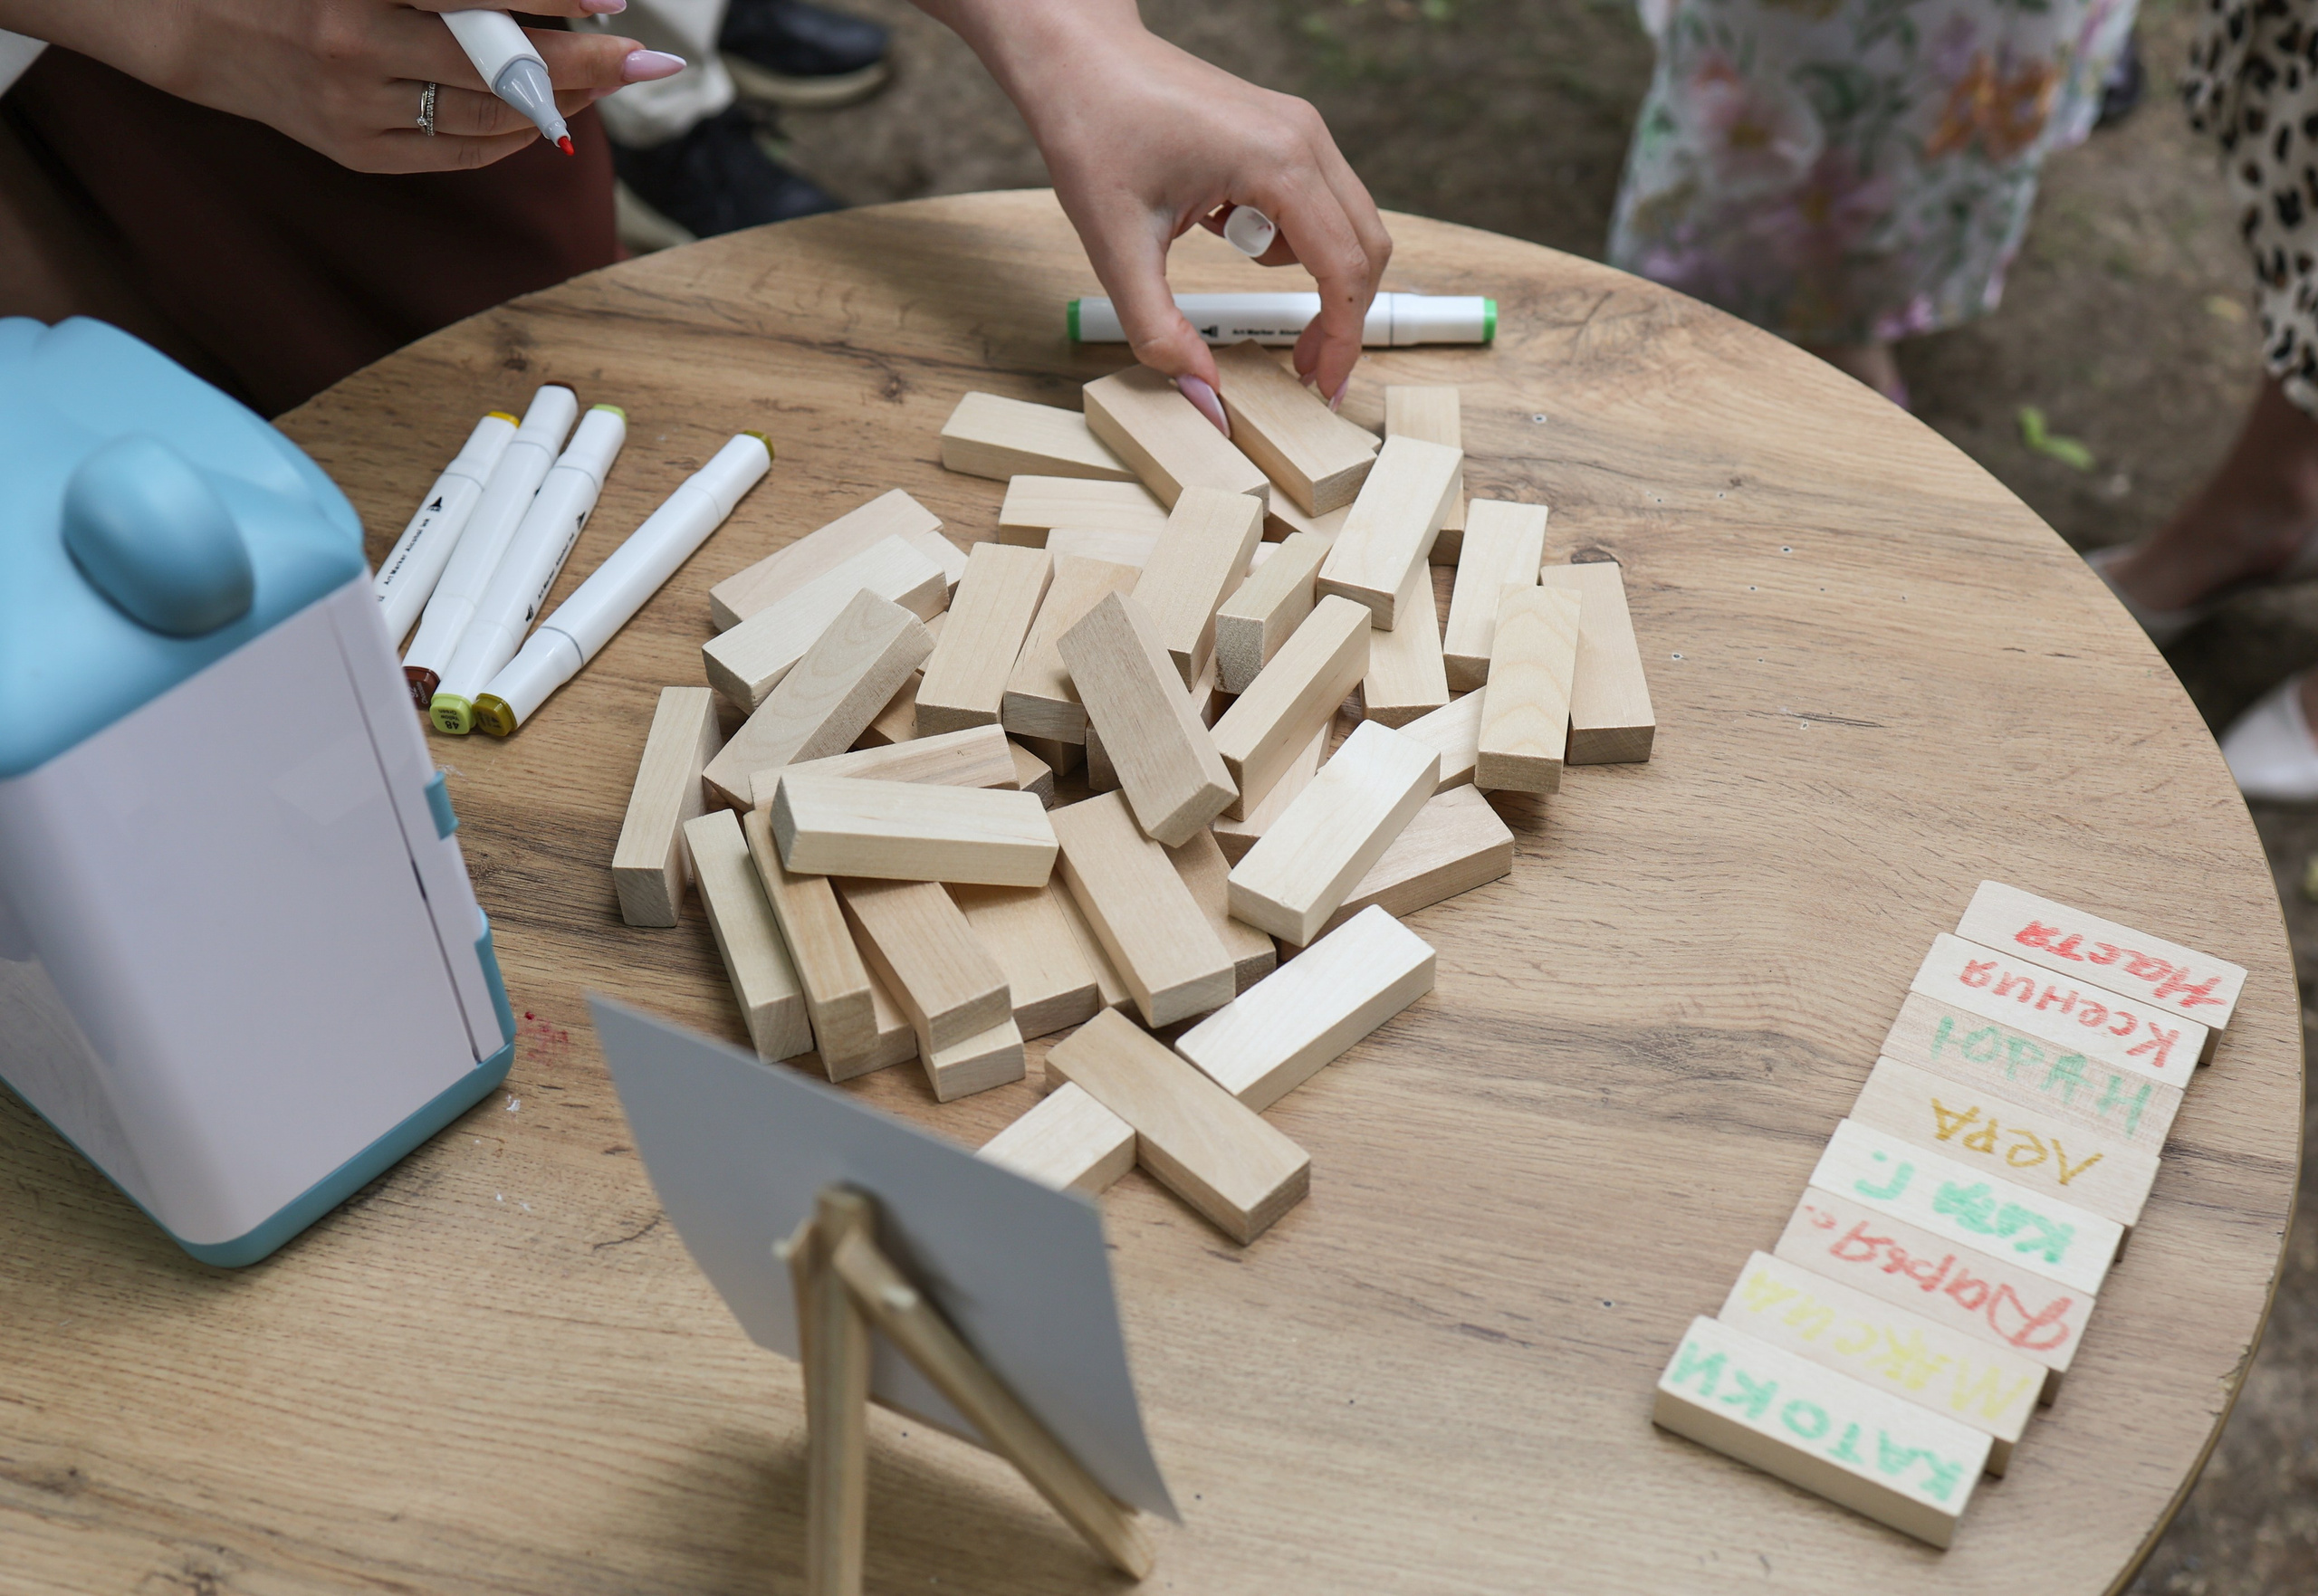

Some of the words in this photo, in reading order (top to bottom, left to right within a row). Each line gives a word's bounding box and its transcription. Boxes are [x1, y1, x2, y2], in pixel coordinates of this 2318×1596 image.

[438, 708, 458, 716] Green
[440, 714, 461, 722] Yellow
[445, 721, 460, 731] 48
[2014, 921, 2228, 1008] Настя
[1959, 959, 2179, 1068] Ксения
